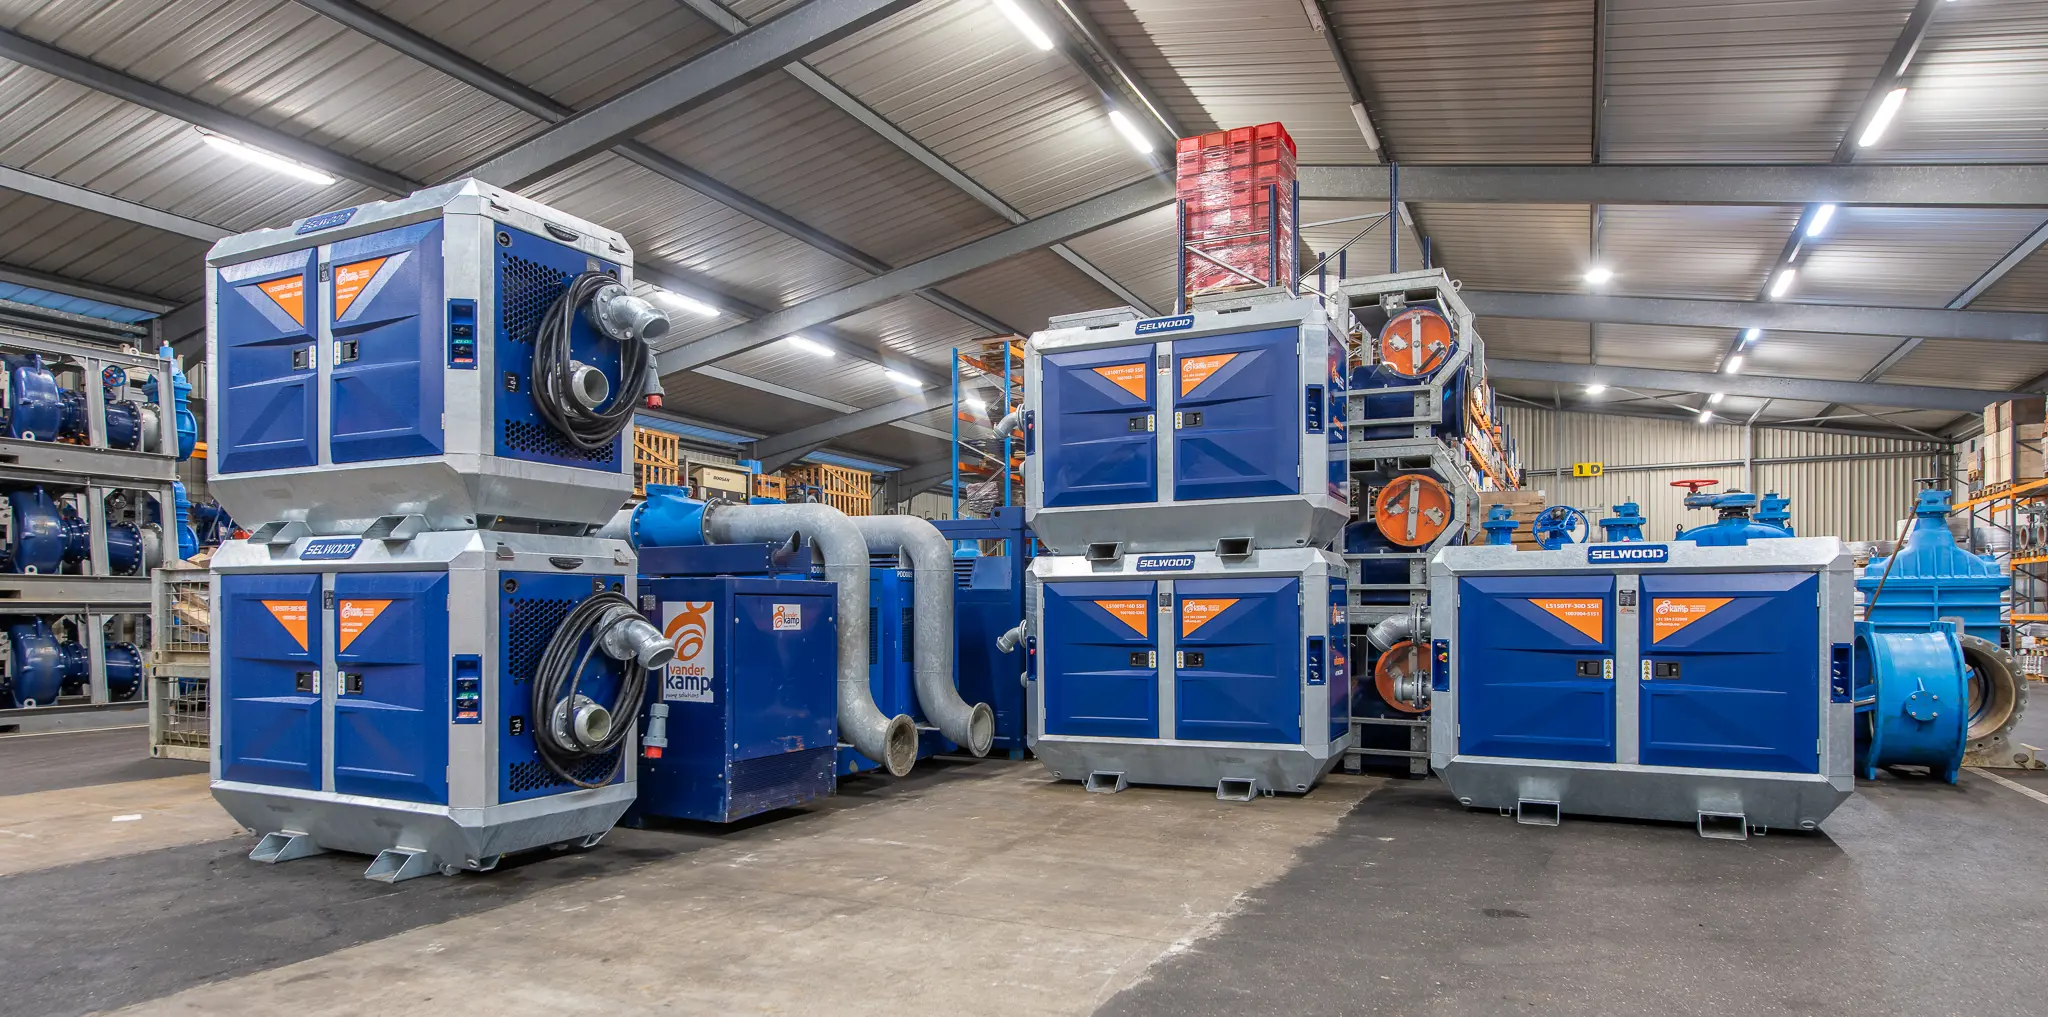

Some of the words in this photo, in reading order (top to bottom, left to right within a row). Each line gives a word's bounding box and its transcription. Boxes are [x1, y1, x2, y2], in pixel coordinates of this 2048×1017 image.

[1138, 318, 1191, 331] SELWOOD
[1578, 465, 1583, 474] 1
[1591, 465, 1600, 474] D
[305, 543, 355, 555] SELWOOD
[1592, 549, 1664, 560] SELWOOD
[1139, 558, 1192, 568] SELWOOD
[784, 614, 799, 626] kamp
[670, 663, 705, 676] vander
[666, 663, 710, 696] kamp
